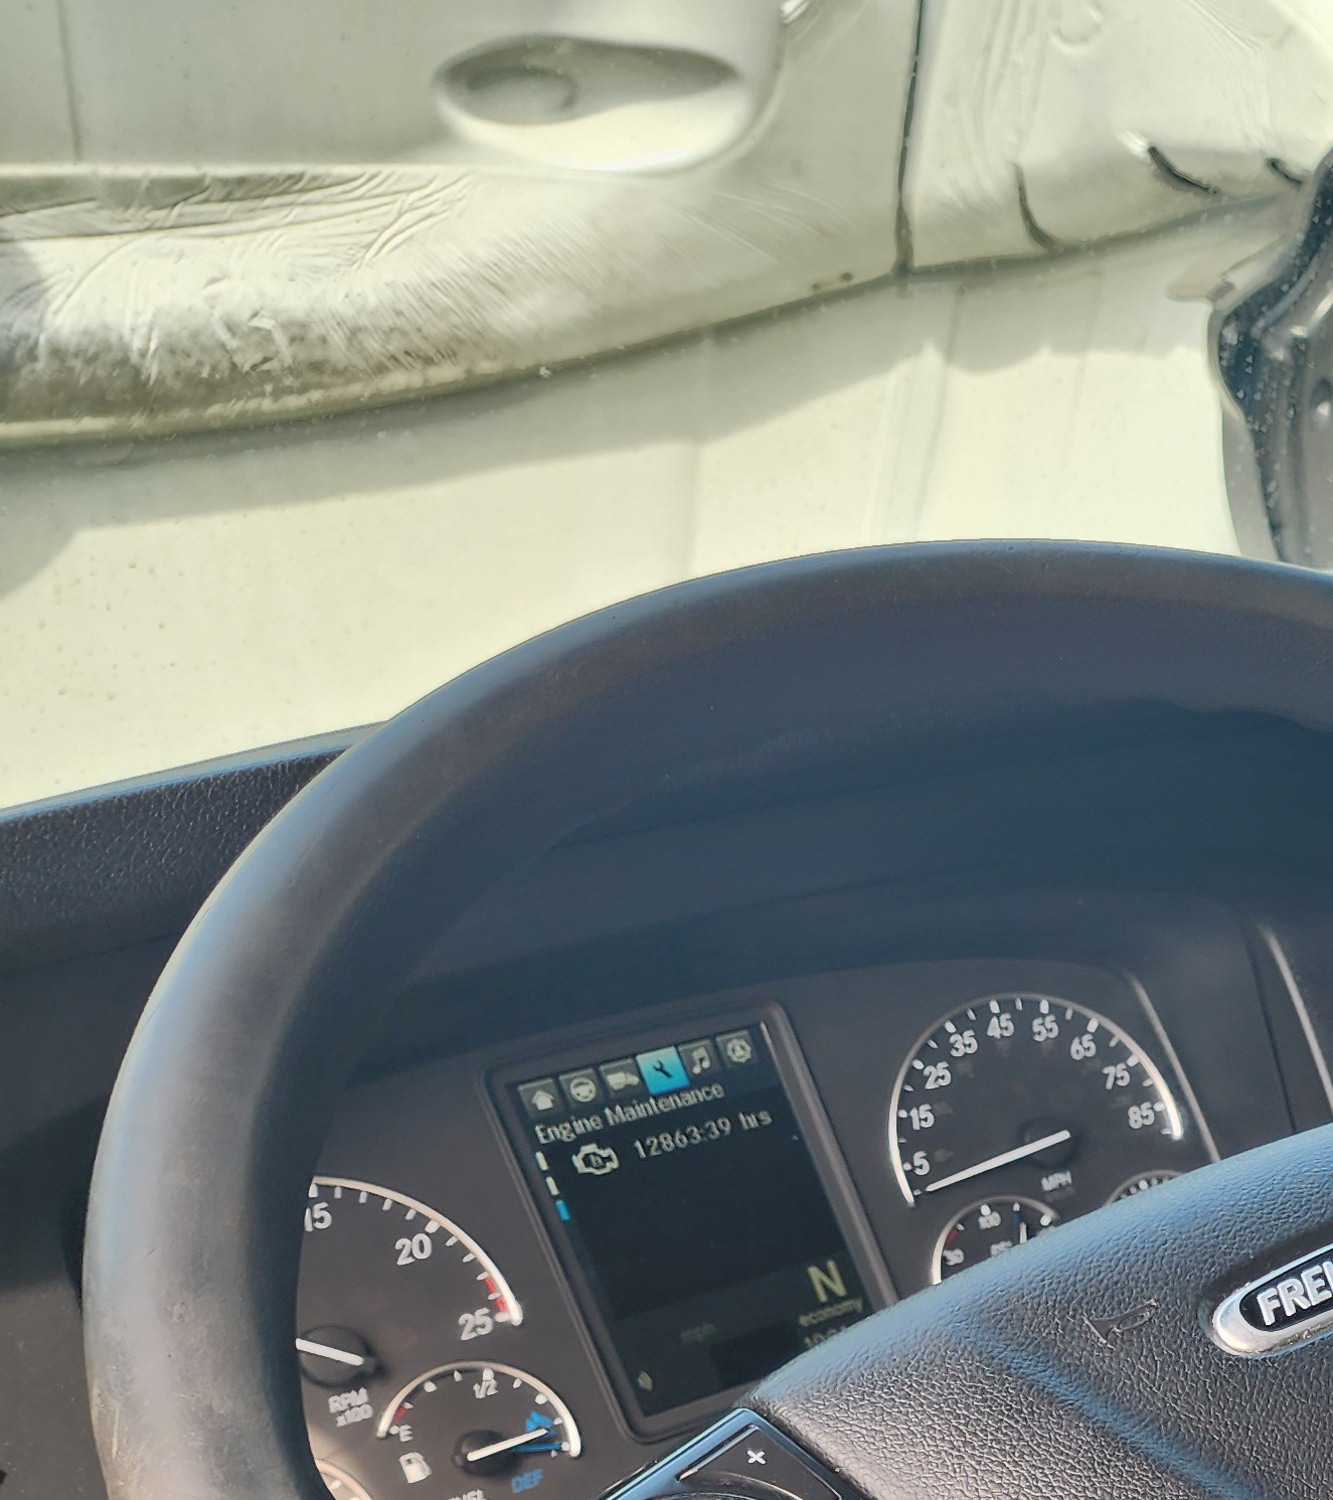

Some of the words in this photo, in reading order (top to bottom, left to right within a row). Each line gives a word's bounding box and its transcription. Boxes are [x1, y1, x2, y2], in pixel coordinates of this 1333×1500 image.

[986, 1012, 1016, 1040] 45
[1032, 1014, 1060, 1042] 55
[949, 1029, 979, 1058] 35
[1070, 1033, 1097, 1061] 65
[923, 1061, 952, 1090] 25
[1102, 1066, 1131, 1090] 75
[534, 1113, 603, 1144] Engine
[604, 1083, 725, 1126] Maintenance
[738, 1110, 773, 1131] hrs
[909, 1103, 935, 1131] 15
[1127, 1102, 1155, 1130] 85
[913, 1150, 930, 1176] 5
[1040, 1170, 1073, 1192] MPH
[304, 1202, 333, 1232] 15
[394, 1233, 432, 1266] 20
[807, 1259, 848, 1302] N
[459, 1306, 494, 1344] 25
[328, 1387, 369, 1413] RPM
[400, 1424, 413, 1442] E
[511, 1469, 545, 1494] DEF
